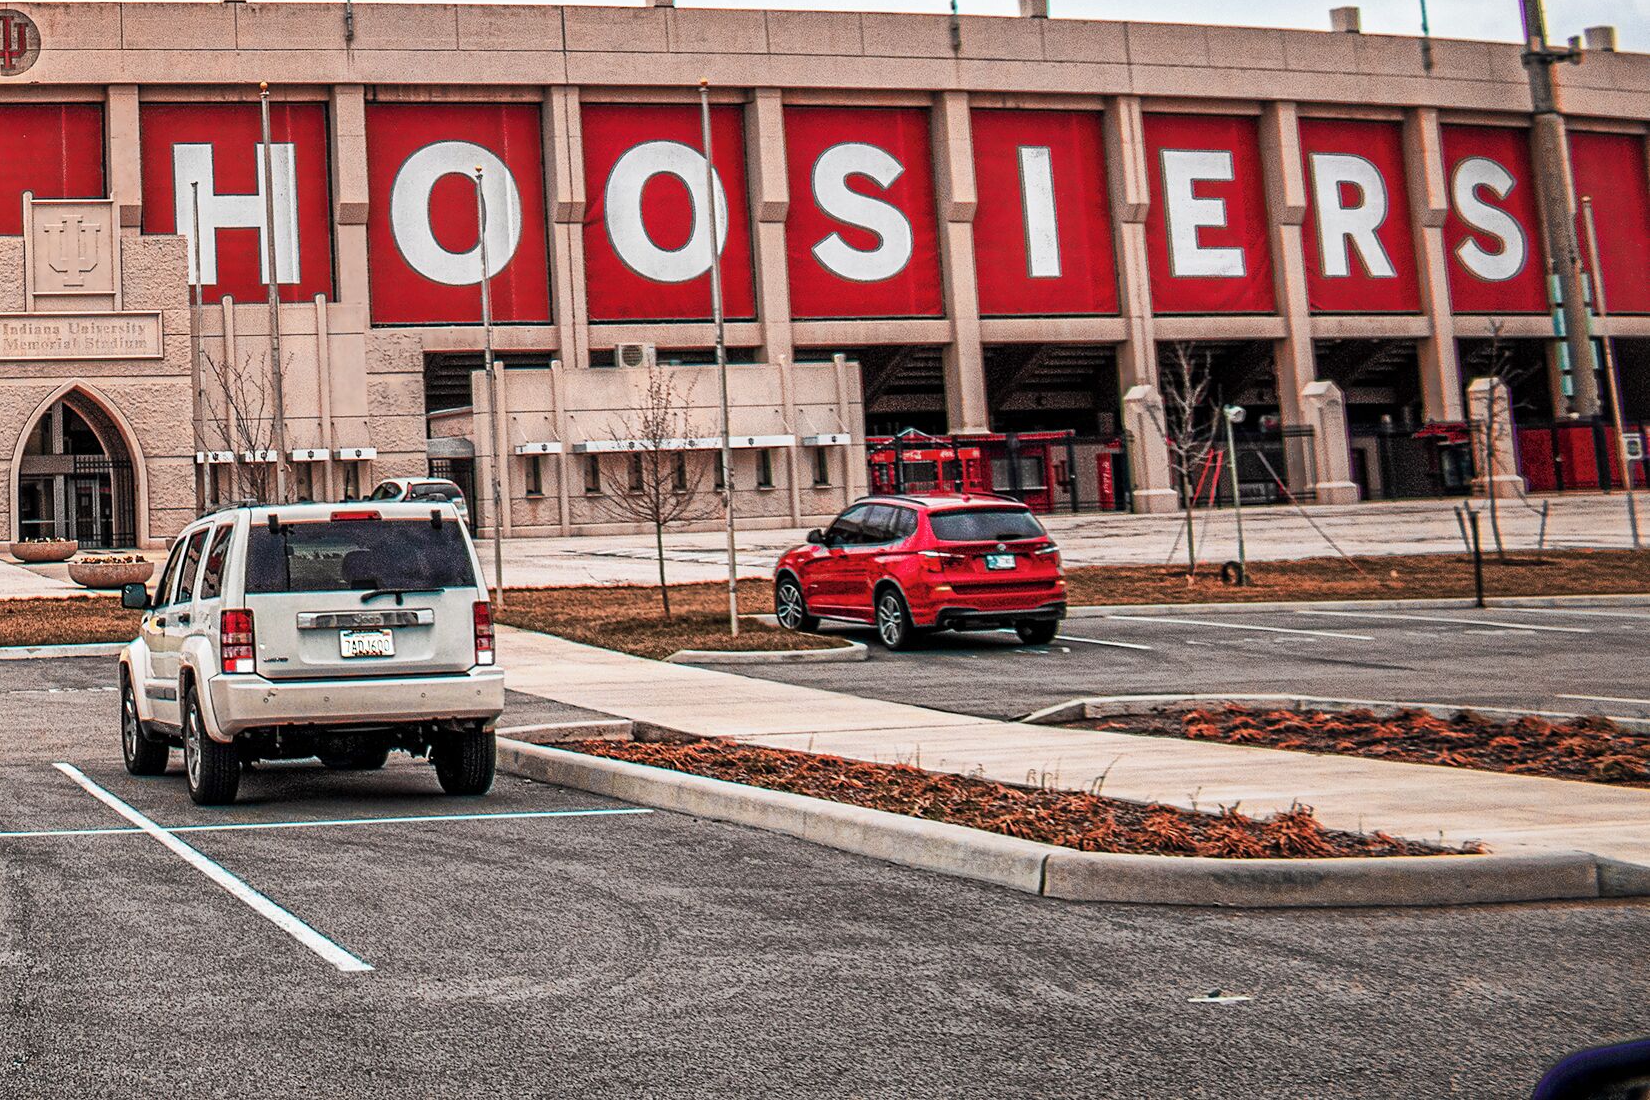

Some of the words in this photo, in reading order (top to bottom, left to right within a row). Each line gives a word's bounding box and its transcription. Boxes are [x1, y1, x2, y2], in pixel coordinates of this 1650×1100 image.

[172, 139, 1529, 286] HOOSIERS
[3, 322, 61, 336] Indiana
[68, 321, 146, 337] University
[3, 337, 78, 351] Memorial
[84, 336, 148, 350] Stadium
